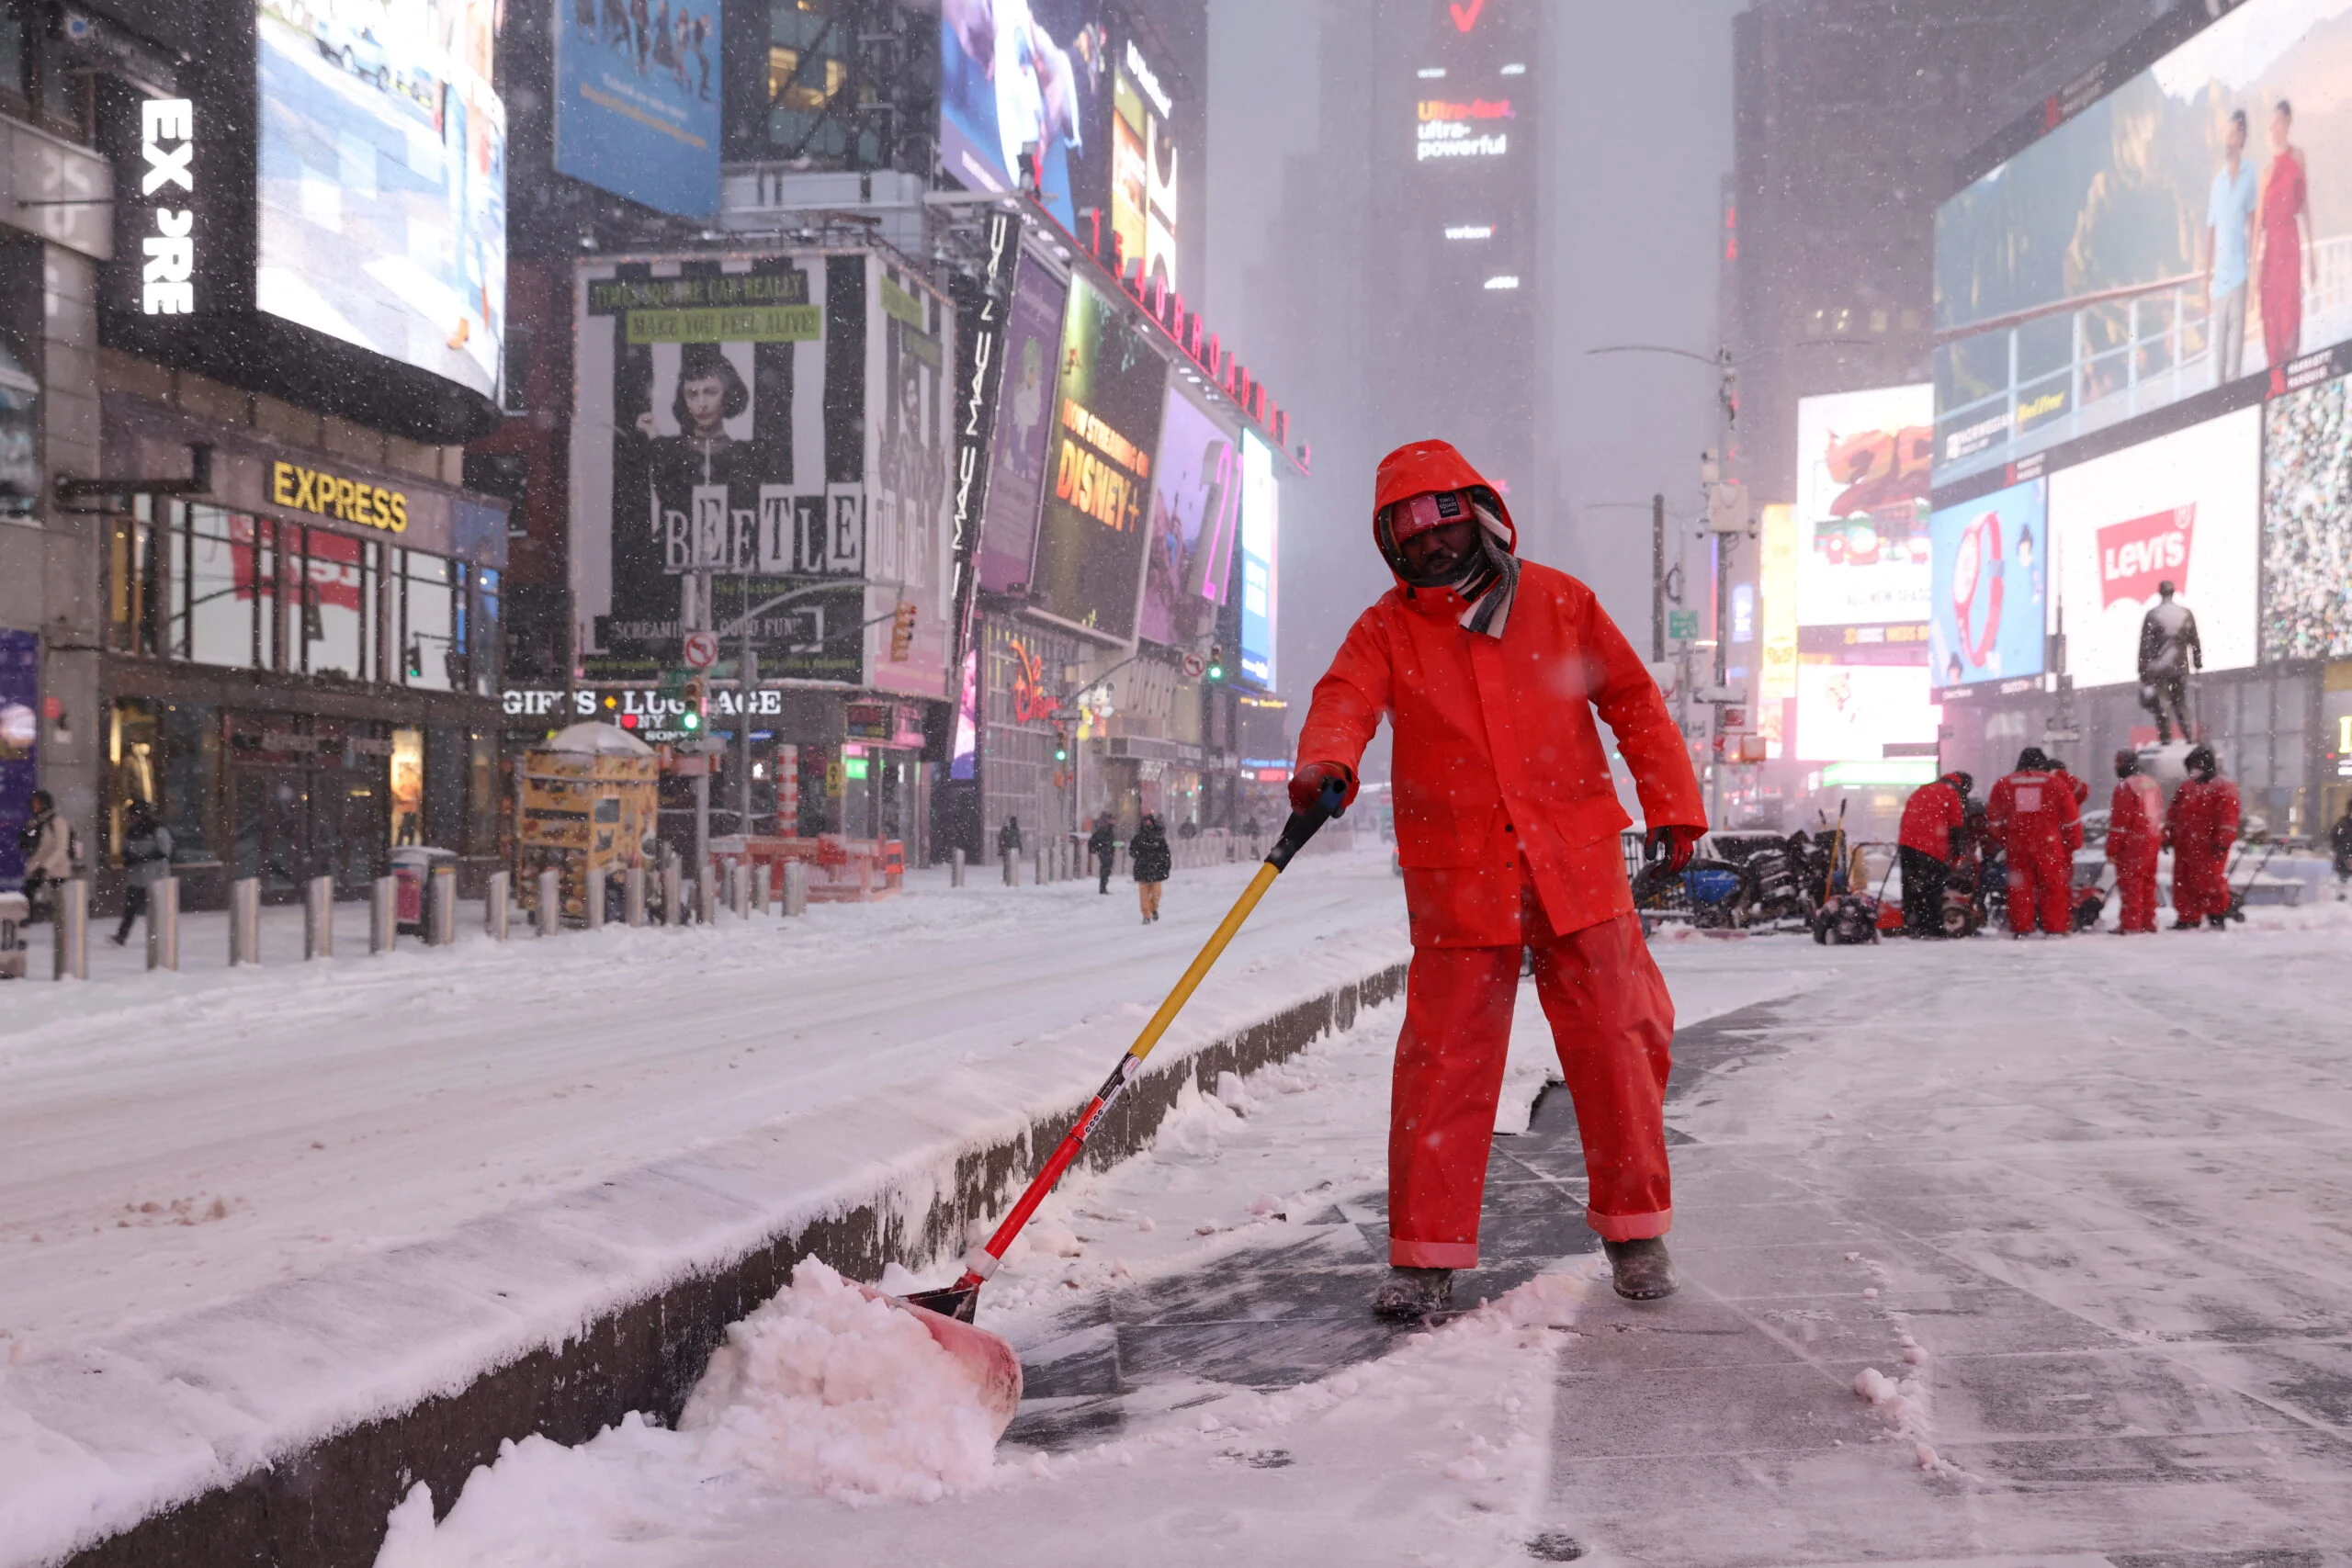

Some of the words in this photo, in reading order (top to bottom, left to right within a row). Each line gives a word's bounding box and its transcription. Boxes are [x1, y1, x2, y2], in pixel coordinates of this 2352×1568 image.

[1418, 134, 1507, 161] powerful
[633, 312, 678, 336] MAKE
[684, 311, 716, 335] YOU
[720, 310, 759, 334] FEEL
[1062, 398, 1090, 438] NOW
[274, 460, 408, 533] EXPRESS
[1057, 439, 1140, 533] DISNEY+
[1439, 502, 1458, 510] SQUARE
[664, 493, 858, 571] BEETLE
[503, 690, 597, 716] GIFS
[623, 690, 782, 716] LUGAGE
